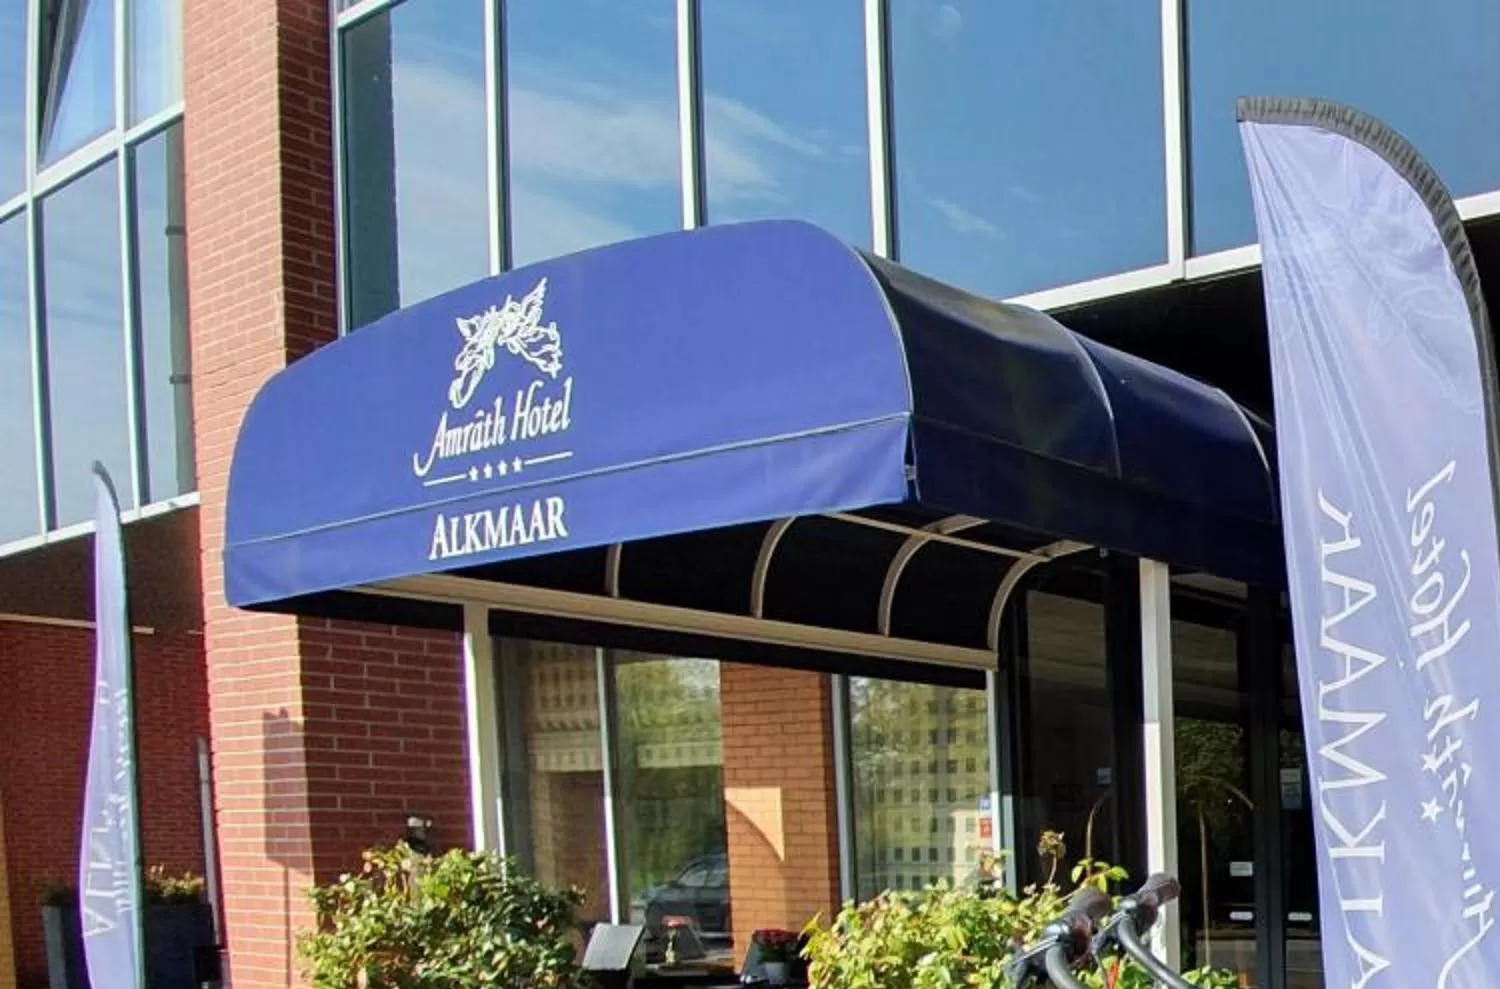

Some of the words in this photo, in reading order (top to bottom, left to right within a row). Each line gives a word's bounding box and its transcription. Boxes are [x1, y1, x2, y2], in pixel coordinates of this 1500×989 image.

[413, 395, 505, 477] Amrâth
[510, 376, 573, 441] Hotel
[429, 496, 569, 561] ALKMAAR
